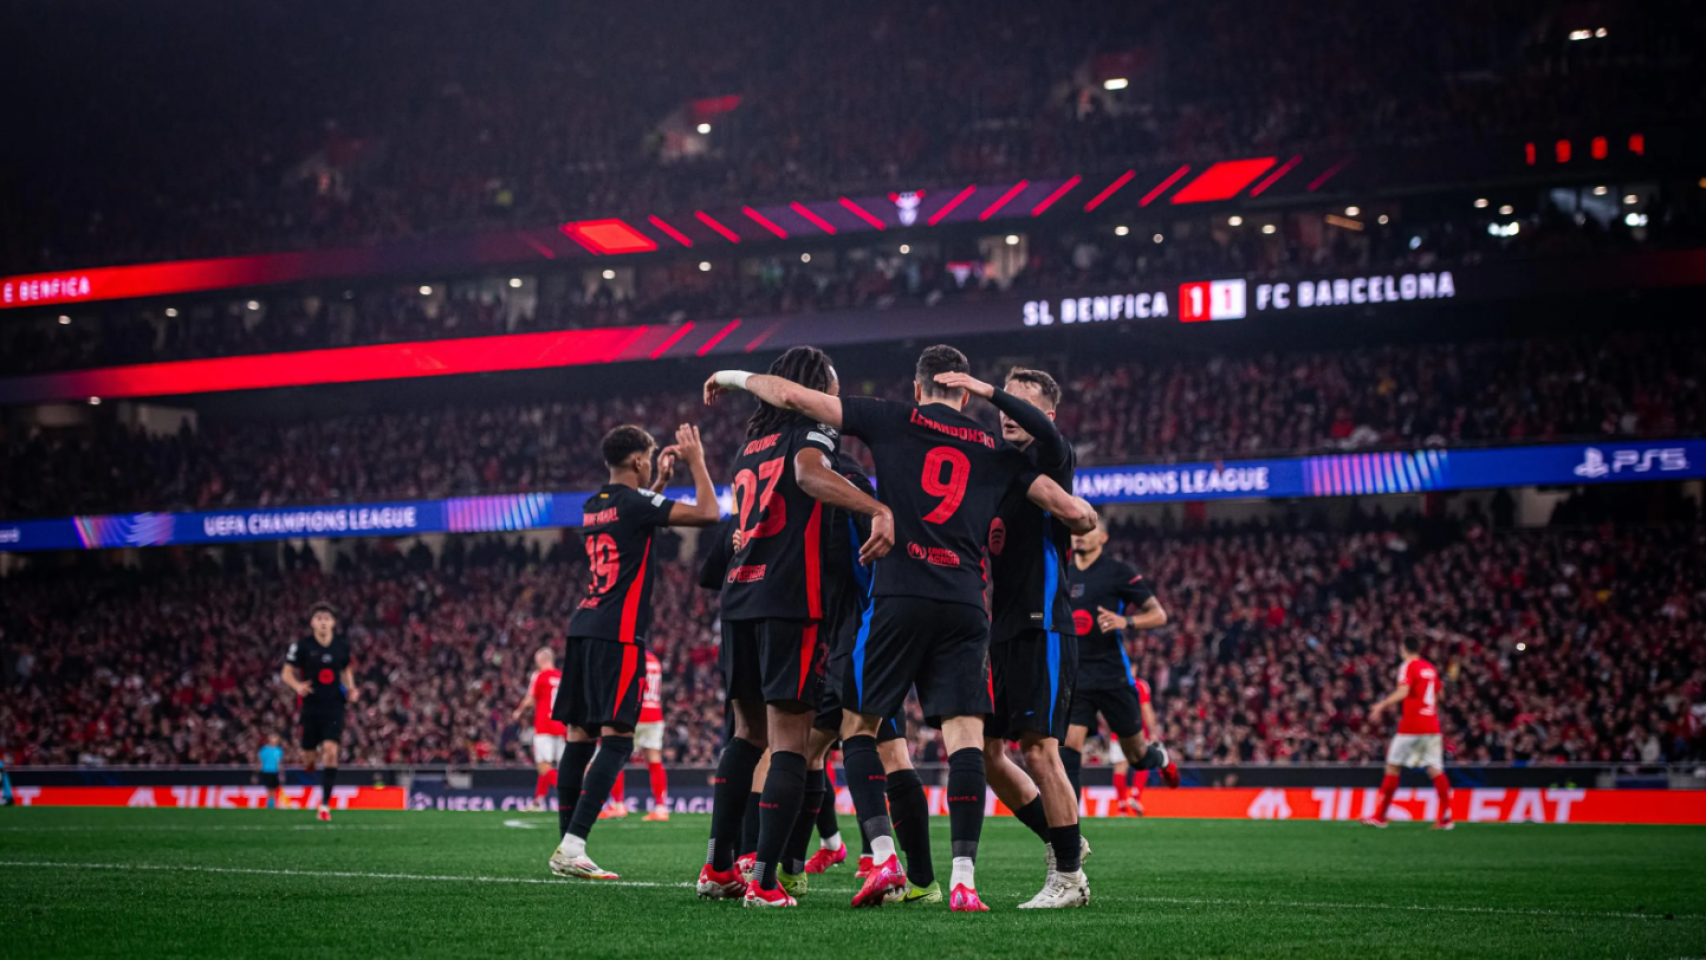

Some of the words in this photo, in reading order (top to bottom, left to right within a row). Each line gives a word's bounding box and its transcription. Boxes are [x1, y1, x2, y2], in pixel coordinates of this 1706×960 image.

[1022, 300, 1054, 326] SL
[1060, 291, 1169, 323] BENFICA
[1189, 285, 1204, 318] 1
[1255, 282, 1291, 310] FC
[1297, 271, 1456, 308] BARCELONA
[1180, 466, 1270, 494] LEAGUE
[1612, 448, 1689, 473] PS5
[734, 456, 787, 546] 23
[921, 446, 971, 525] 9
[203, 514, 248, 537] UEFA
[247, 509, 349, 535] CHAMPIONS
[349, 506, 418, 531] LEAGUE
[584, 532, 621, 595] 19
[1466, 786, 1587, 823] EAT
